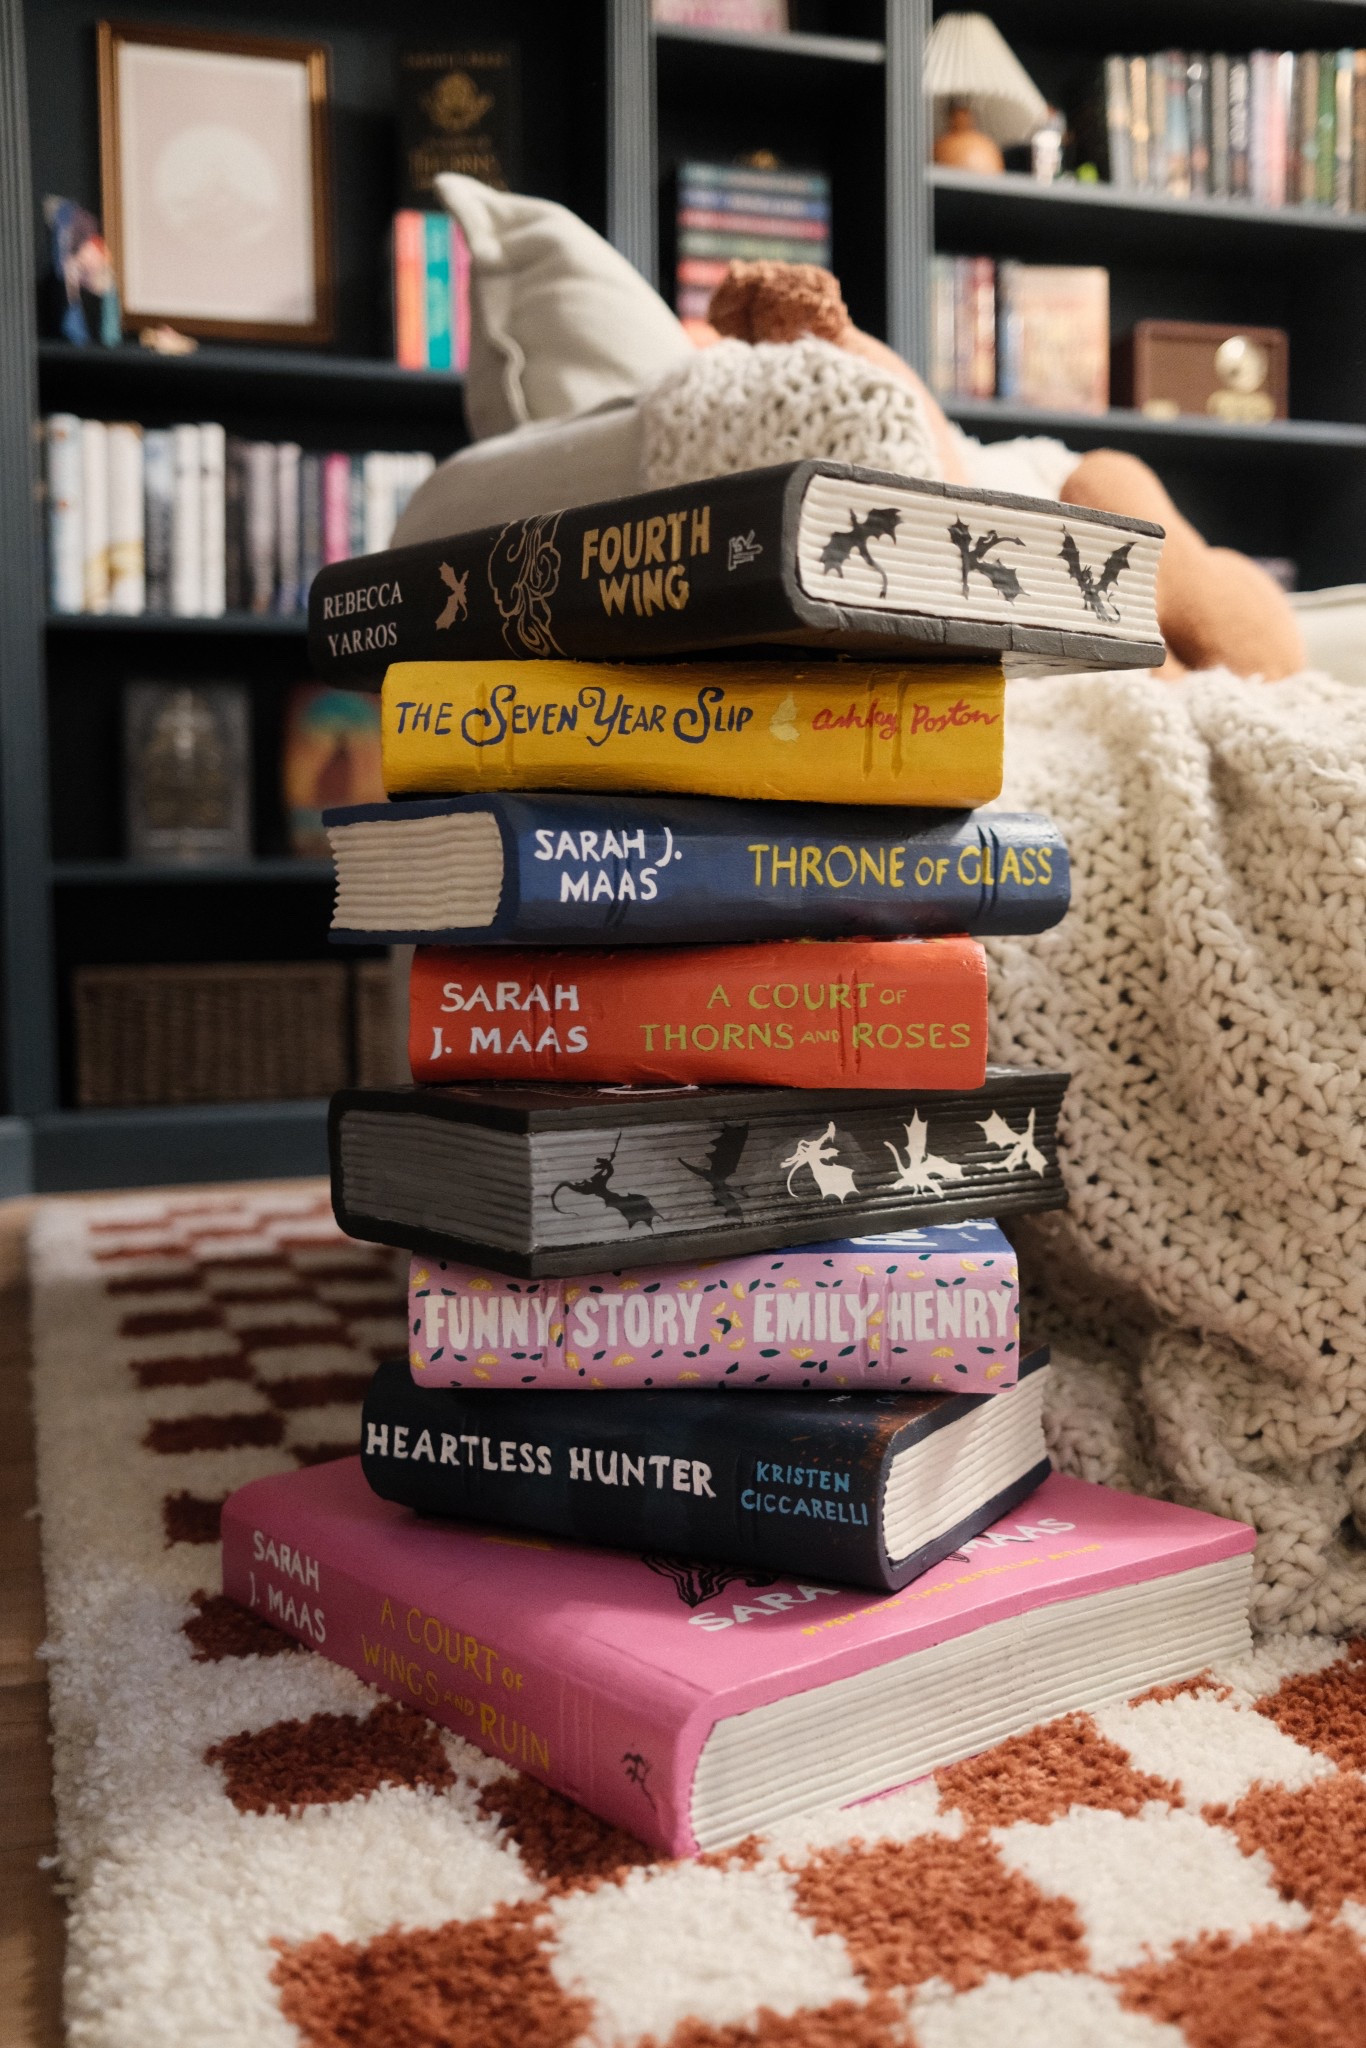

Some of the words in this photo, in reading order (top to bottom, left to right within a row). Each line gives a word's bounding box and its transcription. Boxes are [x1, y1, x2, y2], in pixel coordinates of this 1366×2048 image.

[581, 505, 711, 579] FOURTH
[323, 581, 403, 619] REBECCA
[599, 565, 690, 617] WING
[328, 621, 398, 657] YARROS
[396, 701, 453, 735] THE
[461, 684, 578, 747] SEVEN
[578, 685, 666, 746] YEAR
[672, 685, 753, 744] SLIP
[909, 698, 1000, 735] Poston
[533, 829, 646, 862] SARAH
[654, 827, 682, 867] J.
[747, 844, 906, 888] THRONE
[914, 857, 950, 886] OF
[957, 845, 1053, 888] GLASS
[559, 867, 658, 903] MAAS
[440, 981, 580, 1013] SARAH
[706, 984, 731, 1009] A
[748, 982, 875, 1011] COURT
[880, 987, 908, 1005] OF
[430, 1027, 452, 1060] J.
[470, 1025, 588, 1054] MAAS
[640, 1022, 795, 1053] THORNS
[800, 1029, 841, 1045] AND
[852, 1022, 971, 1050] ROSES
[424, 1293, 557, 1350] FUNNY
[571, 1292, 703, 1349] STORY
[752, 1290, 882, 1343] EMILY
[887, 1287, 1012, 1342] HENRY
[365, 1422, 552, 1476] HEARTLESS
[569, 1447, 717, 1499] HUNTER
[754, 1460, 851, 1493] KRISTEN
[740, 1488, 868, 1527] CICCARELLI
[253, 1531, 320, 1593] SARAH
[267, 1583, 326, 1643] MAAS
[688, 1584, 840, 1633] SARA
[380, 1598, 396, 1630] A
[405, 1608, 499, 1687] COURT
[502, 1667, 523, 1691] OF
[362, 1634, 440, 1706] WINGS
[479, 1704, 549, 1771] RUIN
